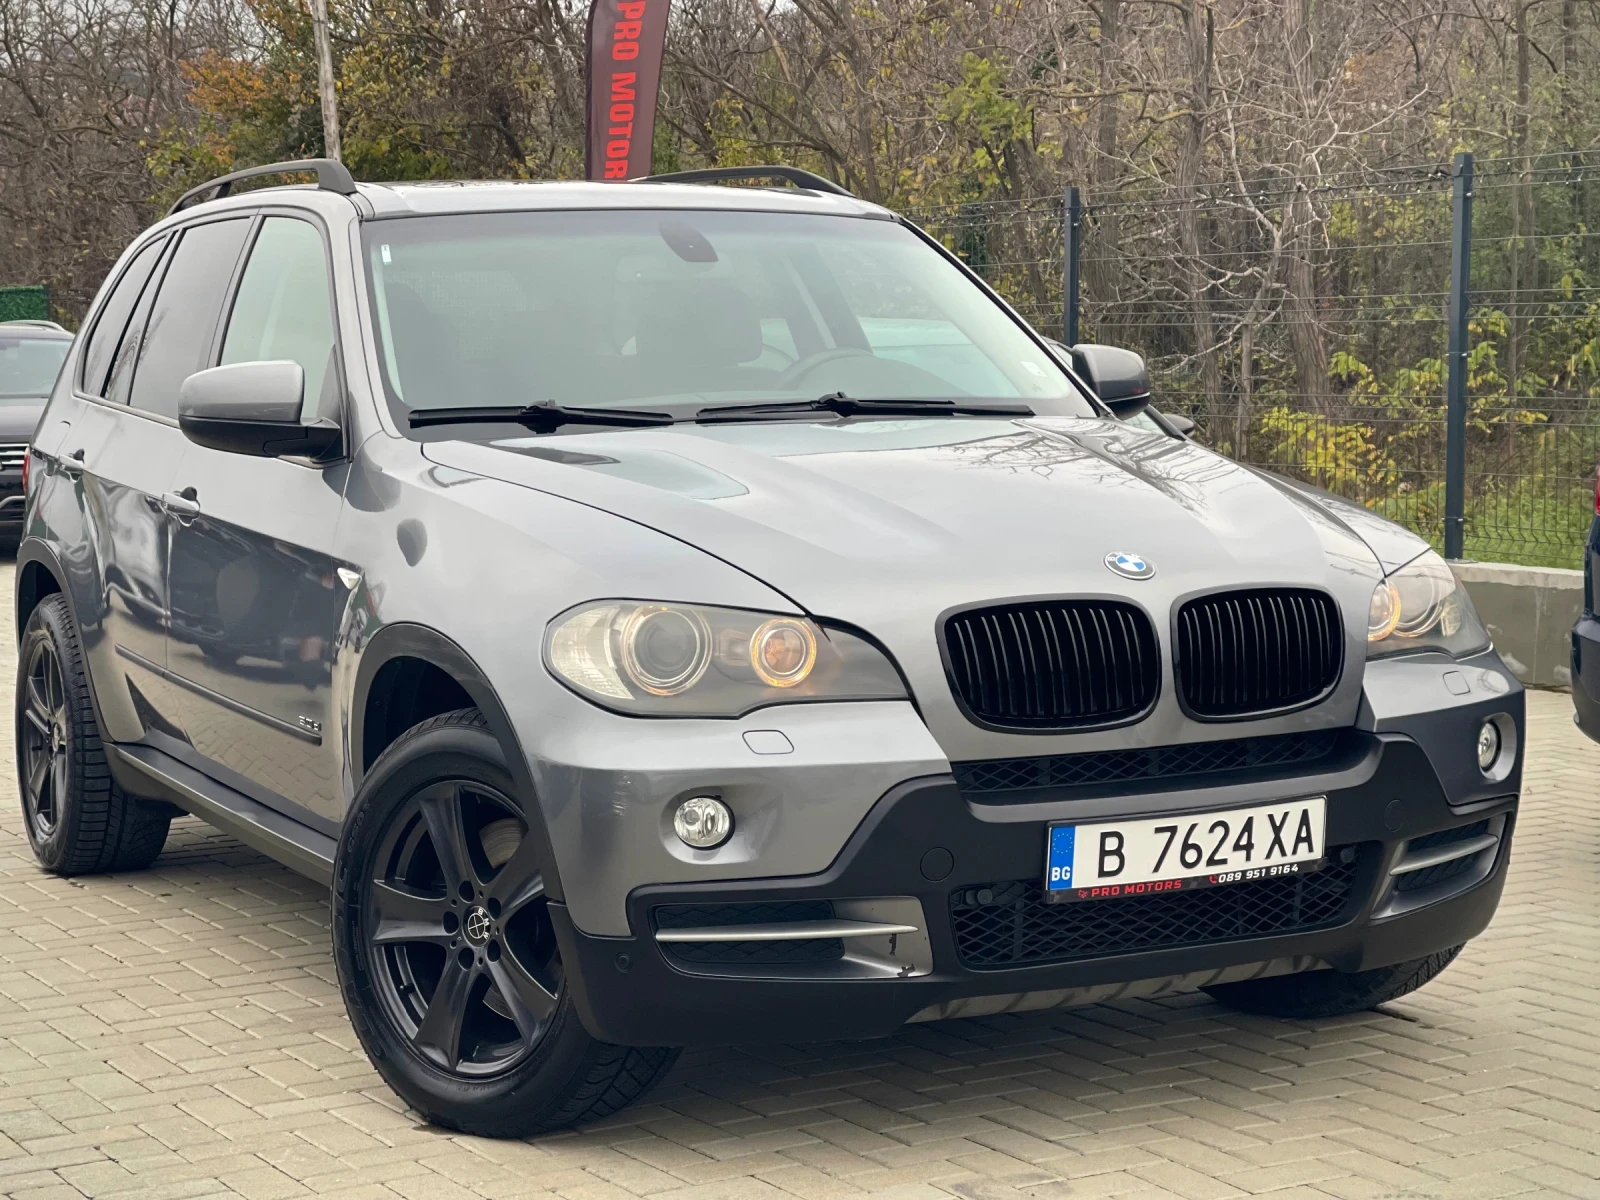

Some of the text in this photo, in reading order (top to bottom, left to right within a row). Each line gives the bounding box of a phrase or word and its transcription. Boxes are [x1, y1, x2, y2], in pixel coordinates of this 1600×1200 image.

[611, 1, 646, 61] PRO
[1097, 830, 1126, 879] B
[1151, 815, 1255, 874] 7624
[1051, 866, 1071, 882] BG
[1217, 863, 1299, 884] 089 951 9164
[1091, 879, 1183, 898] PRO MOTORS
